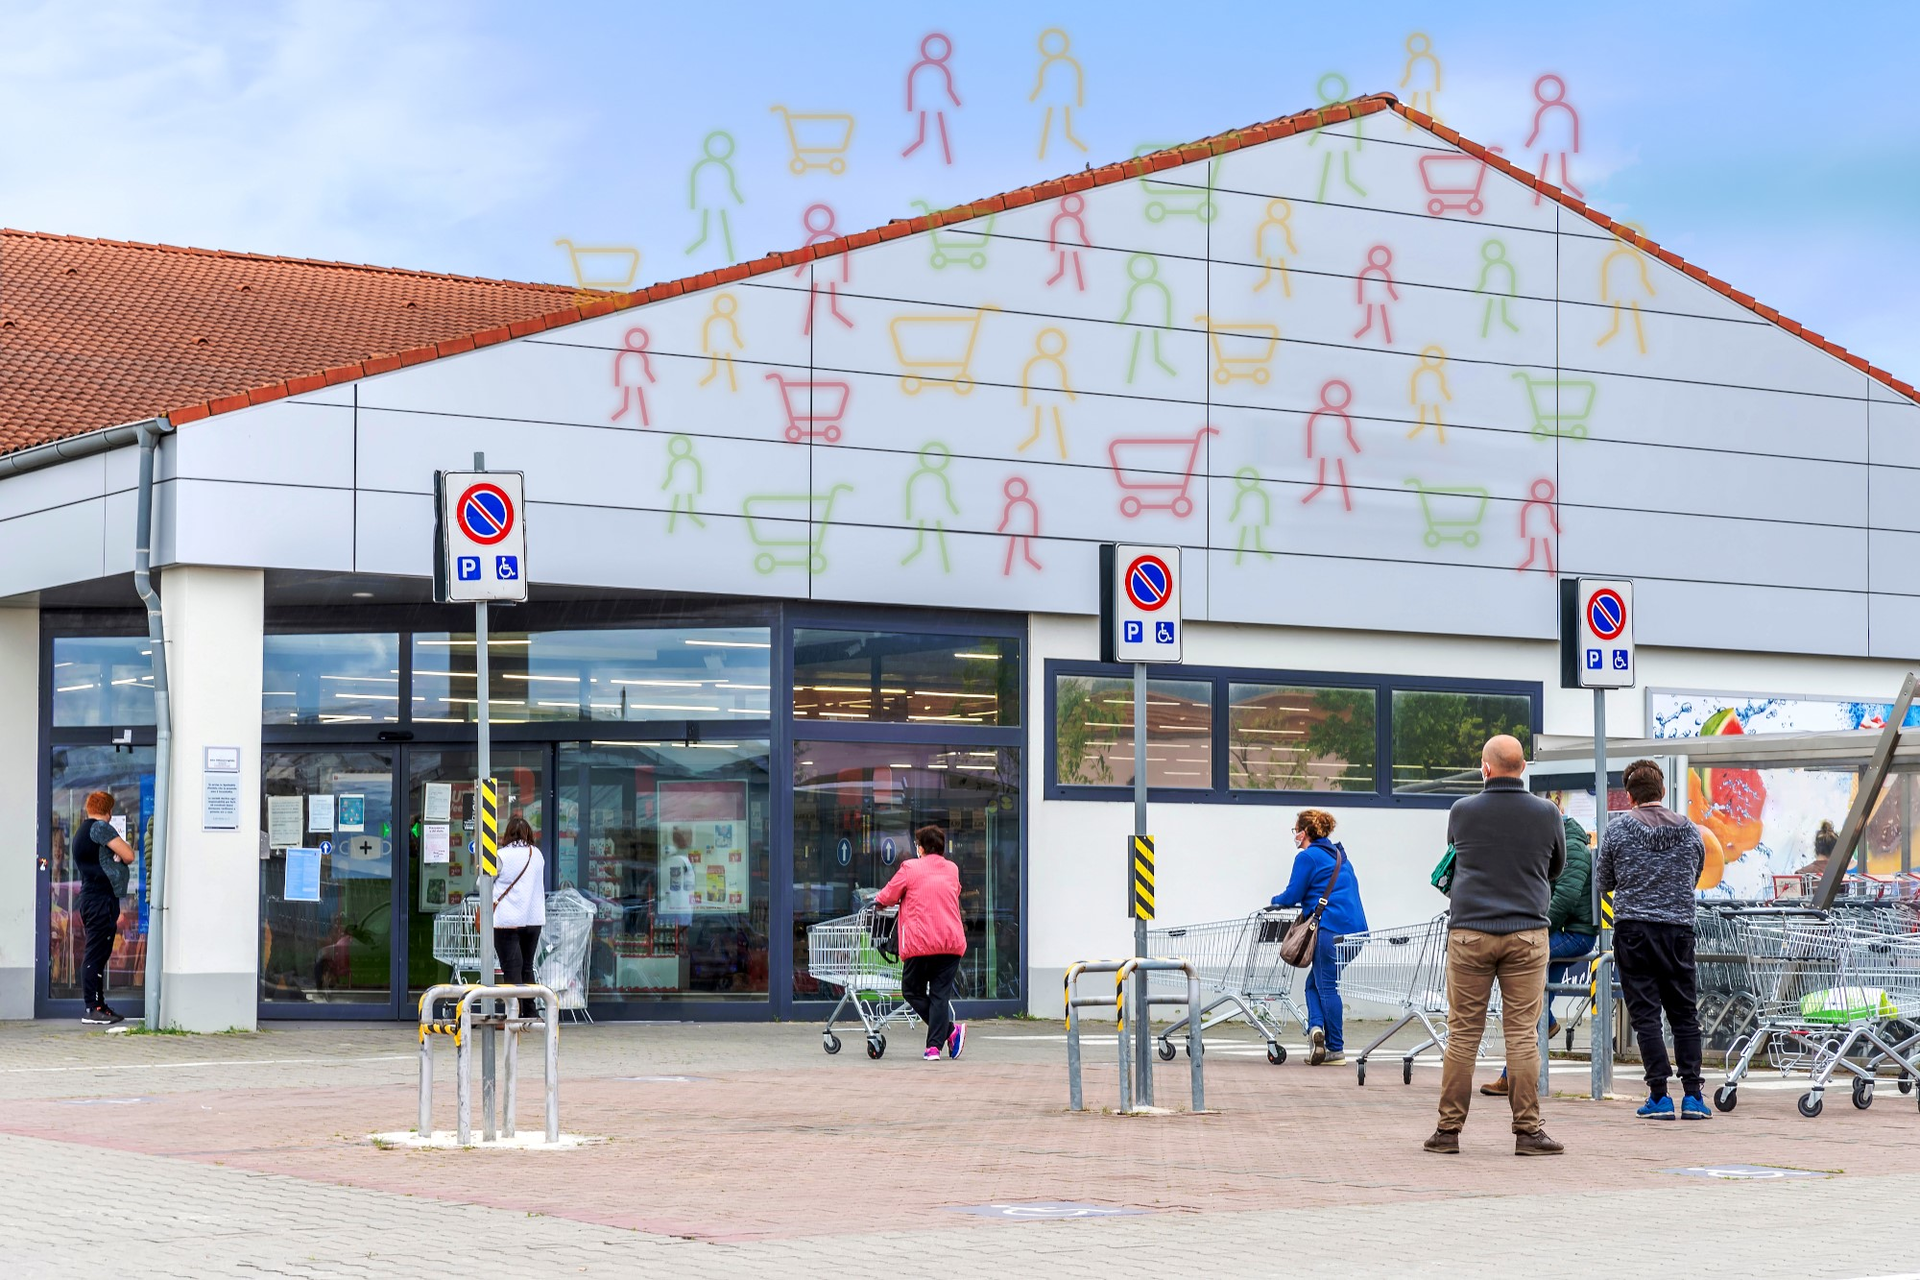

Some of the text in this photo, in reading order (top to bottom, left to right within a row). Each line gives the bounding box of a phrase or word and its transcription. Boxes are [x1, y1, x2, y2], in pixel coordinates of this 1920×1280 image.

[462, 558, 476, 578] P
[1127, 622, 1139, 641] P
[1589, 651, 1600, 668] P
